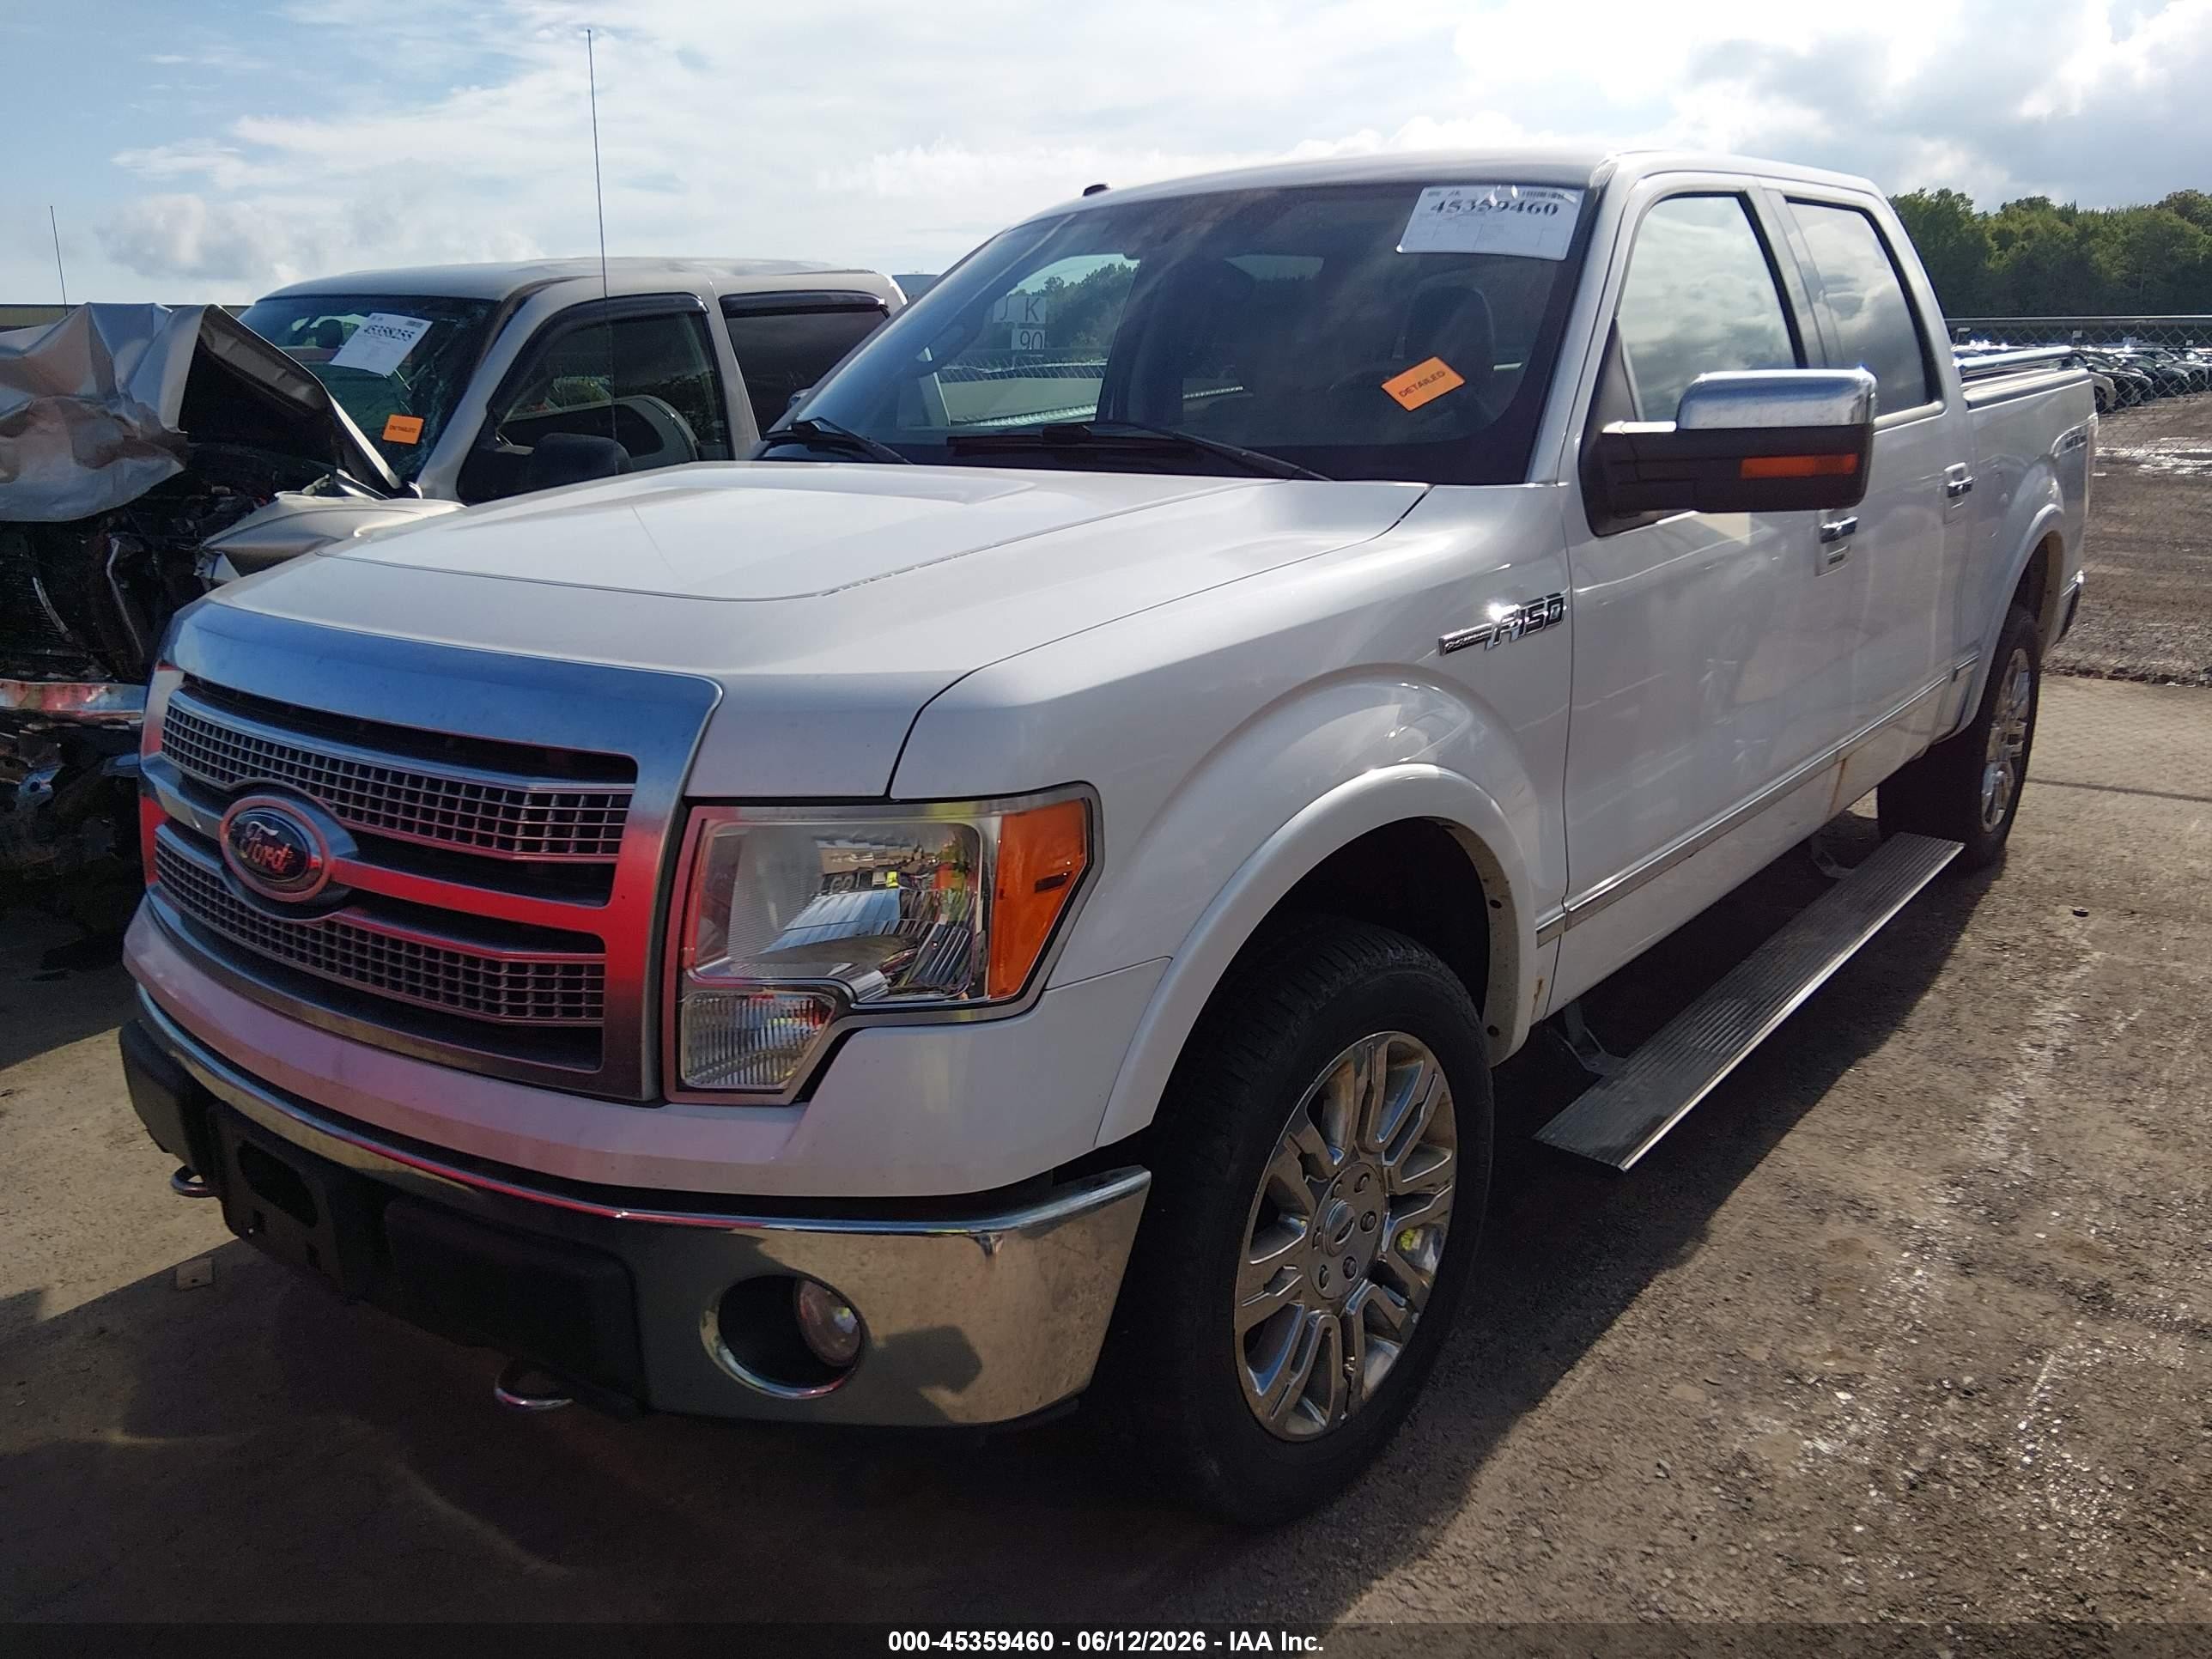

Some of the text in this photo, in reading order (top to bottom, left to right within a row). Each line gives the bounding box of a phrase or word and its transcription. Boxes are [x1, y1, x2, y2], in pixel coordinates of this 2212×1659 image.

[1430, 198, 1559, 216] 45359460
[1024, 296, 1041, 322] K
[1398, 370, 1446, 398] DETAILED
[239, 820, 291, 873] Ford
